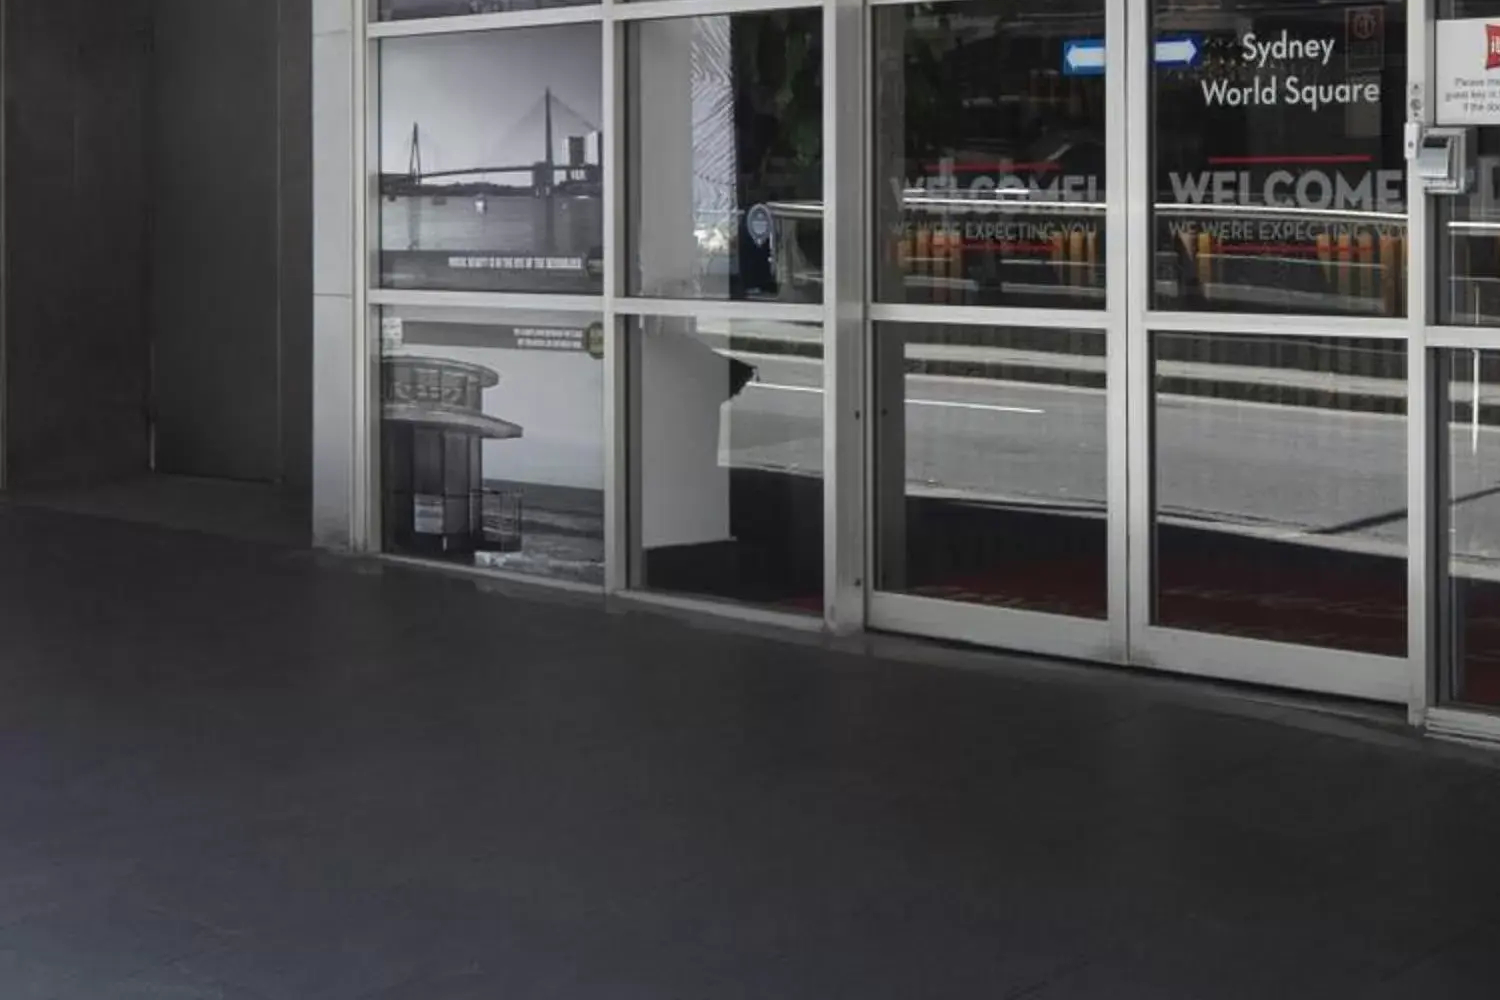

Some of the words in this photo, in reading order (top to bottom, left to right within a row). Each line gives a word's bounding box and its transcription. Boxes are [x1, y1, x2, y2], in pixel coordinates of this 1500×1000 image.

[1242, 30, 1336, 69] Sydney
[1201, 76, 1277, 106] World
[1284, 73, 1382, 112] Square
[965, 221, 1055, 241] EXPECTING
[1061, 221, 1097, 239] YOU
[1168, 220, 1197, 238] WE
[1201, 220, 1254, 240] WERE
[1258, 221, 1368, 242] EXPECTING
